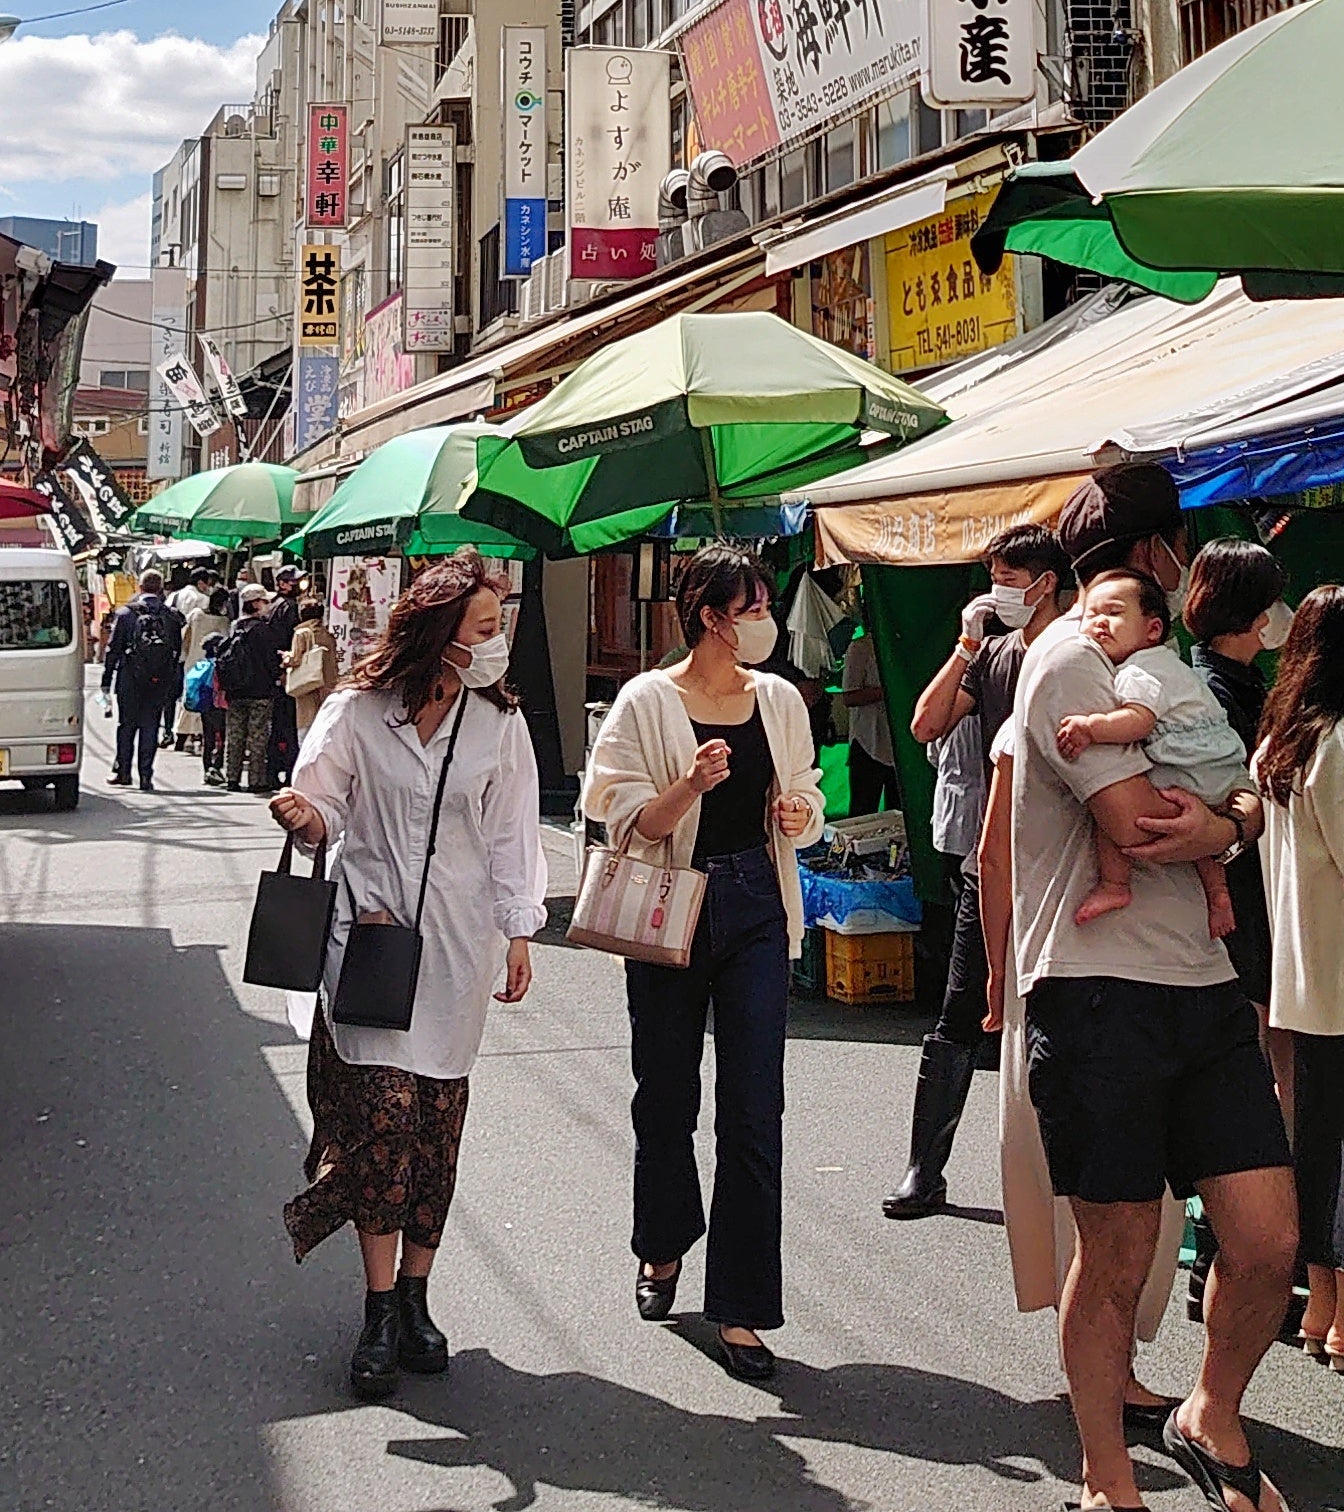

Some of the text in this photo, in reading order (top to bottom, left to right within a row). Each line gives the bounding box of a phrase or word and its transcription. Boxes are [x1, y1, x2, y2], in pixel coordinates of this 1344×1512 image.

[385, 2, 437, 10] SUSHIZANMAI
[773, 61, 800, 107] 築地
[778, 75, 849, 131] 03-3543-5228
[518, 41, 533, 183] コウチ マーケット
[315, 113, 341, 217] 中華幸軒
[606, 89, 642, 221] よすが庵
[581, 241, 658, 262] 占い処
[302, 252, 338, 316] 茶
[916, 330, 933, 356] TEL
[558, 414, 654, 454] CAPTAIN STAG
[336, 525, 375, 546] CAPTAIN
